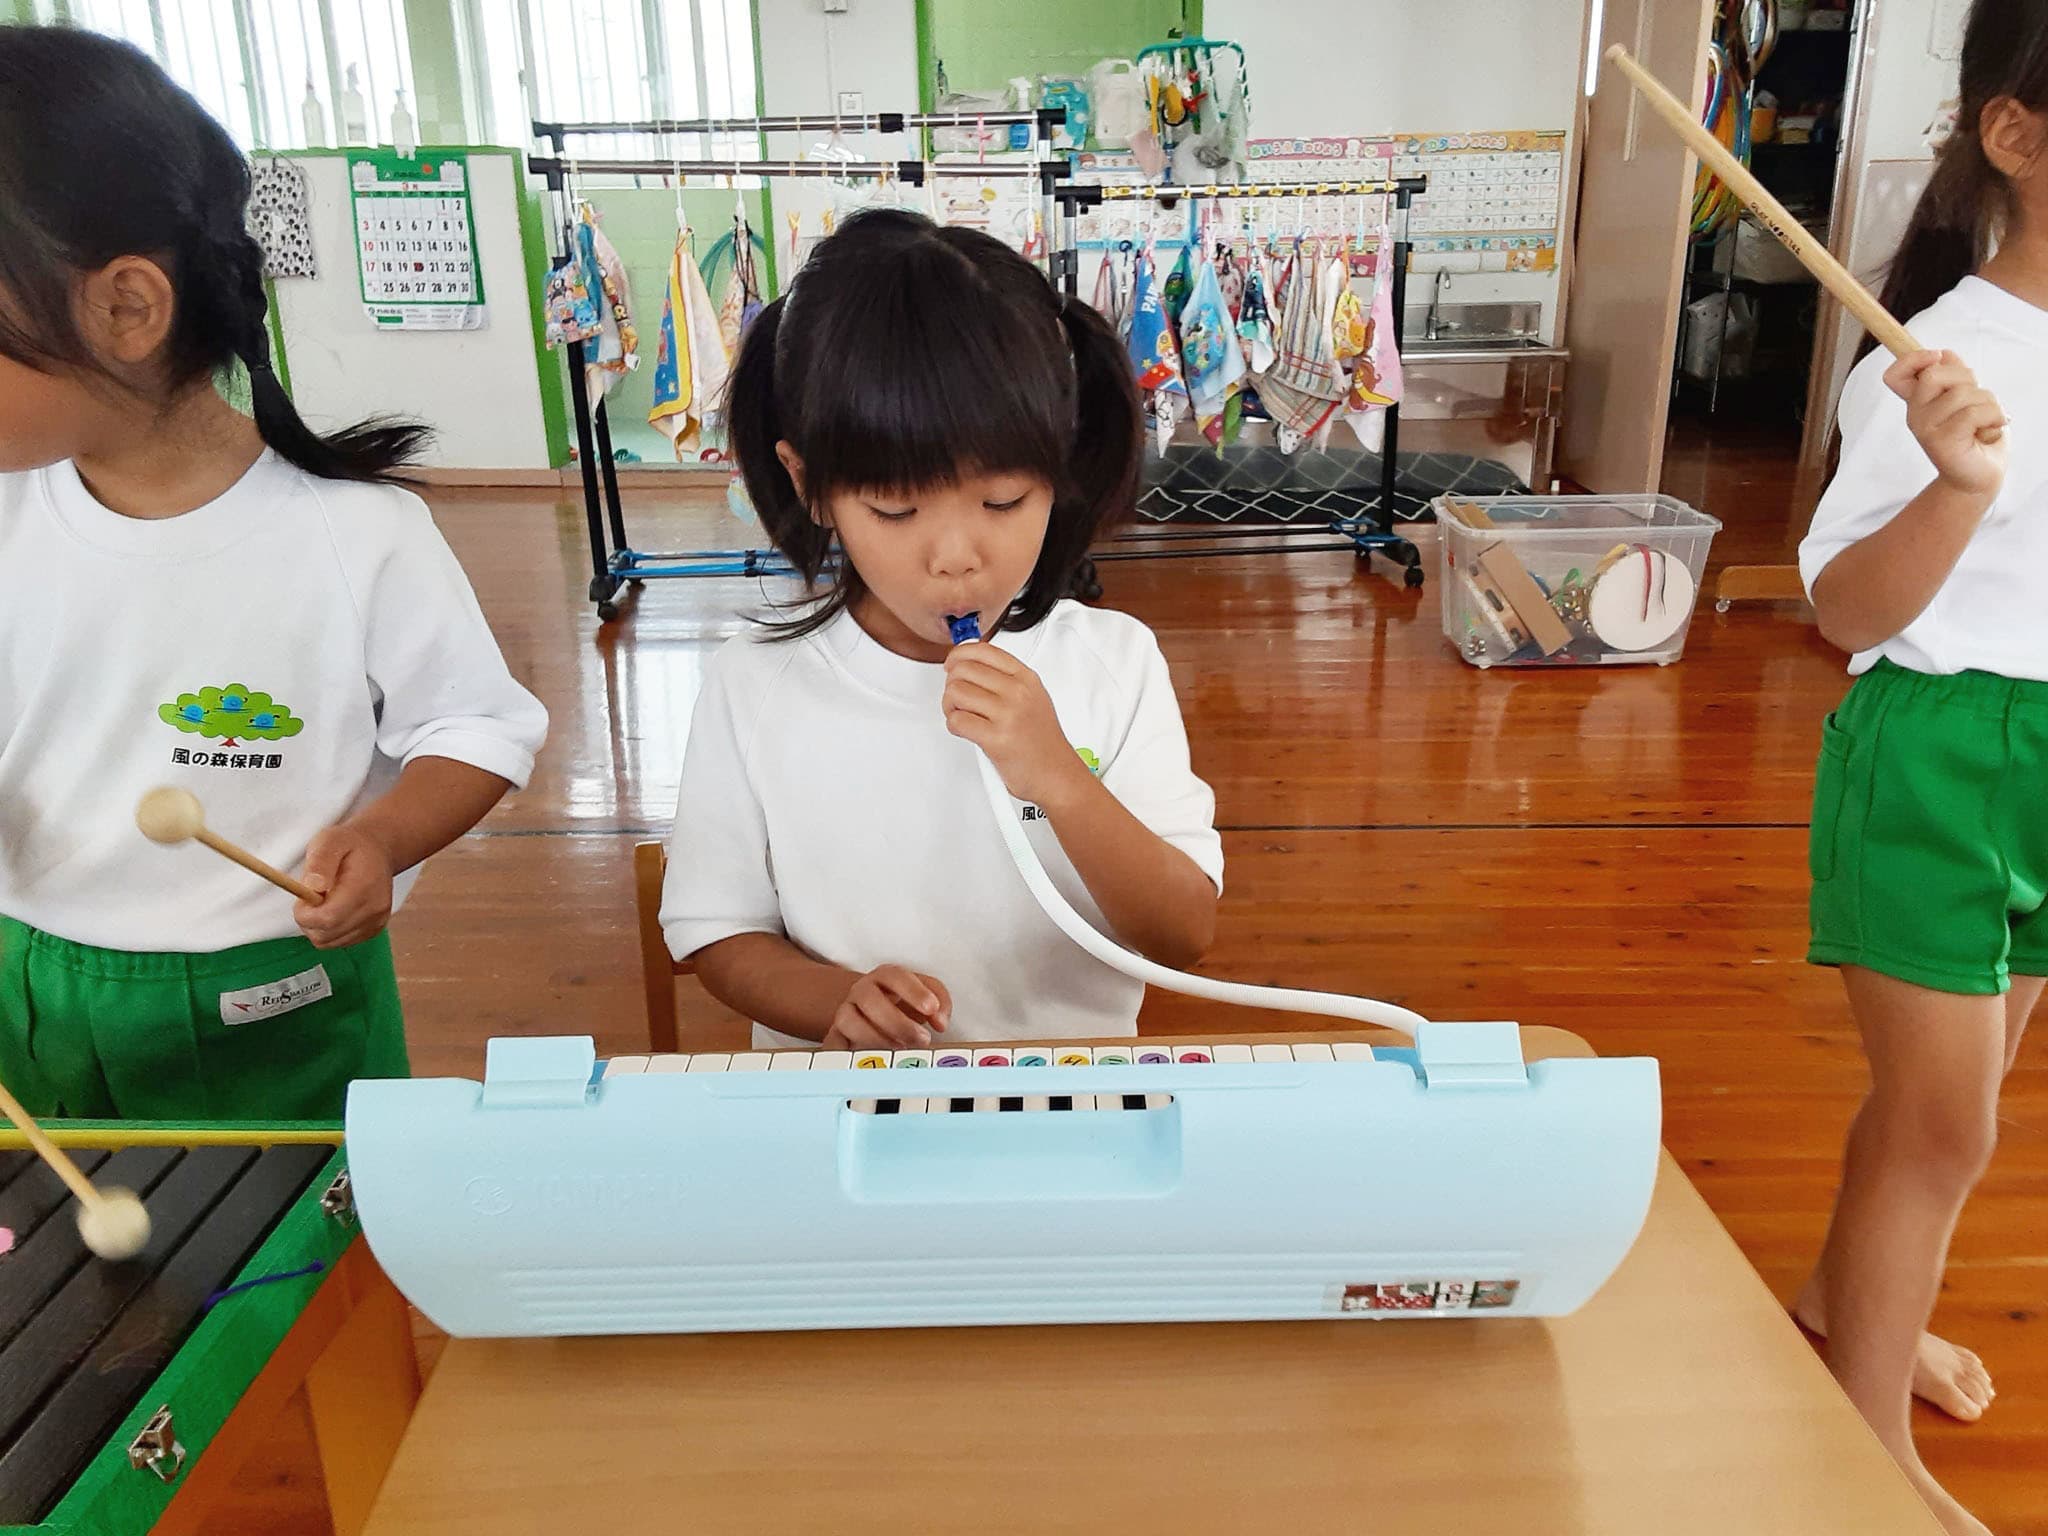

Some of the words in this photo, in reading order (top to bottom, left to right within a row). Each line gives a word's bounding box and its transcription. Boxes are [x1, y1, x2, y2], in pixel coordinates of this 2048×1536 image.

[442, 200, 445, 210] 1
[456, 200, 461, 210] 2
[364, 221, 369, 231] 3
[380, 221, 385, 231] 4
[396, 221, 401, 231] 5
[412, 221, 417, 231] 6
[427, 221, 432, 231] 7
[443, 221, 448, 231] 8
[458, 221, 463, 231] 9
[364, 241, 374, 251] 10
[380, 241, 389, 251] 11
[396, 241, 406, 251] 12
[412, 241, 421, 251] 13
[428, 241, 437, 251] 14
[443, 241, 452, 251] 15
[459, 241, 467, 251] 16
[366, 262, 375, 272] 17
[382, 262, 392, 272] 18
[399, 262, 407, 272] 19
[429, 262, 439, 272] 21
[445, 262, 455, 272] 22
[460, 262, 469, 272] 23
[384, 282, 394, 292] 25
[400, 282, 410, 292] 26
[416, 282, 425, 292] 27
[432, 283, 442, 292] 28
[448, 283, 456, 292] 29
[171, 747, 282, 769] 風の森保育園
